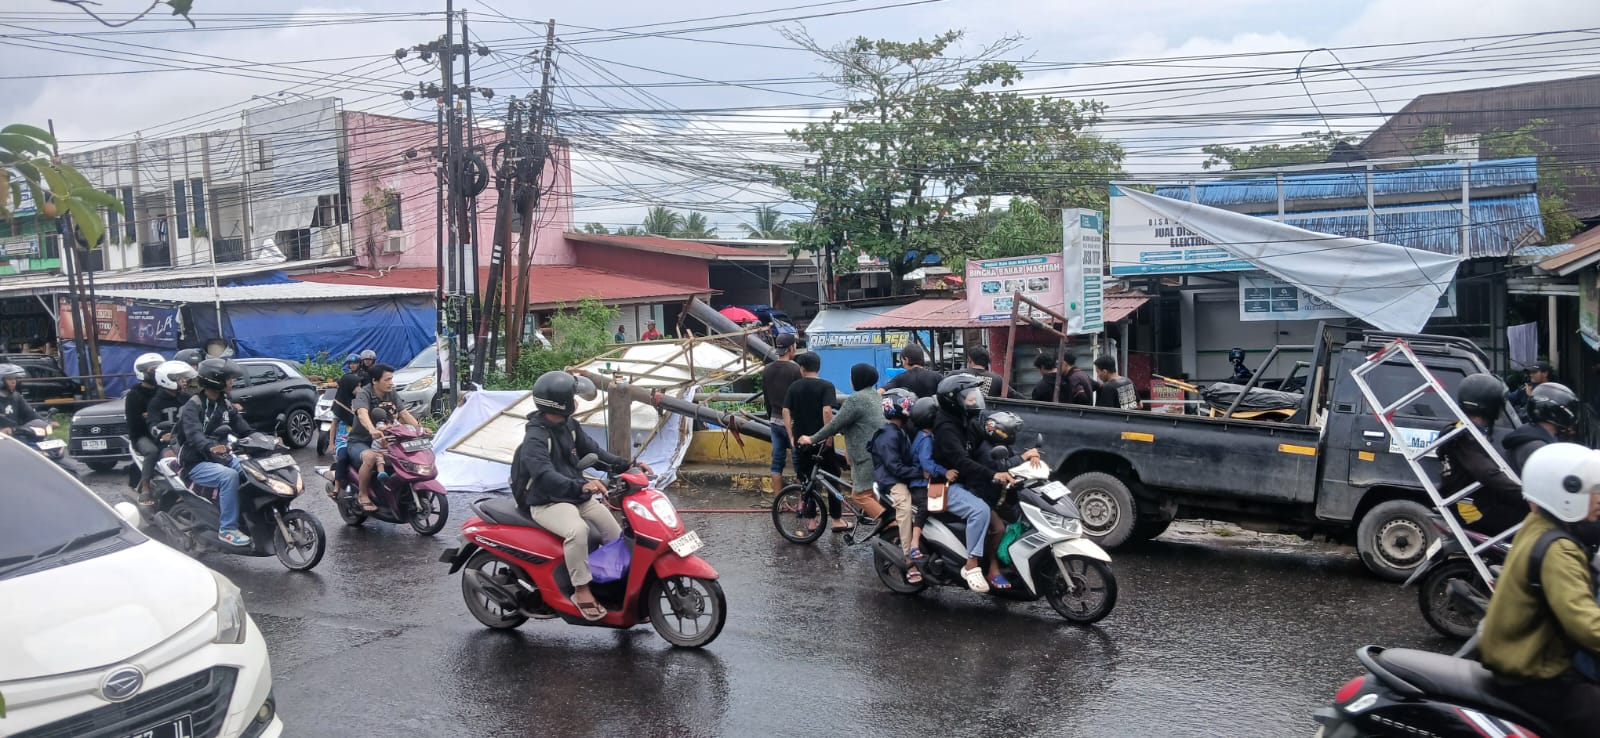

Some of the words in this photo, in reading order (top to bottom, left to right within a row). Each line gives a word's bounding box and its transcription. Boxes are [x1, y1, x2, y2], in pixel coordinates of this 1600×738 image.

[1154, 227, 1174, 238] JUAL
[998, 266, 1023, 275] BAKAR
[1025, 263, 1060, 273] MASITAH
